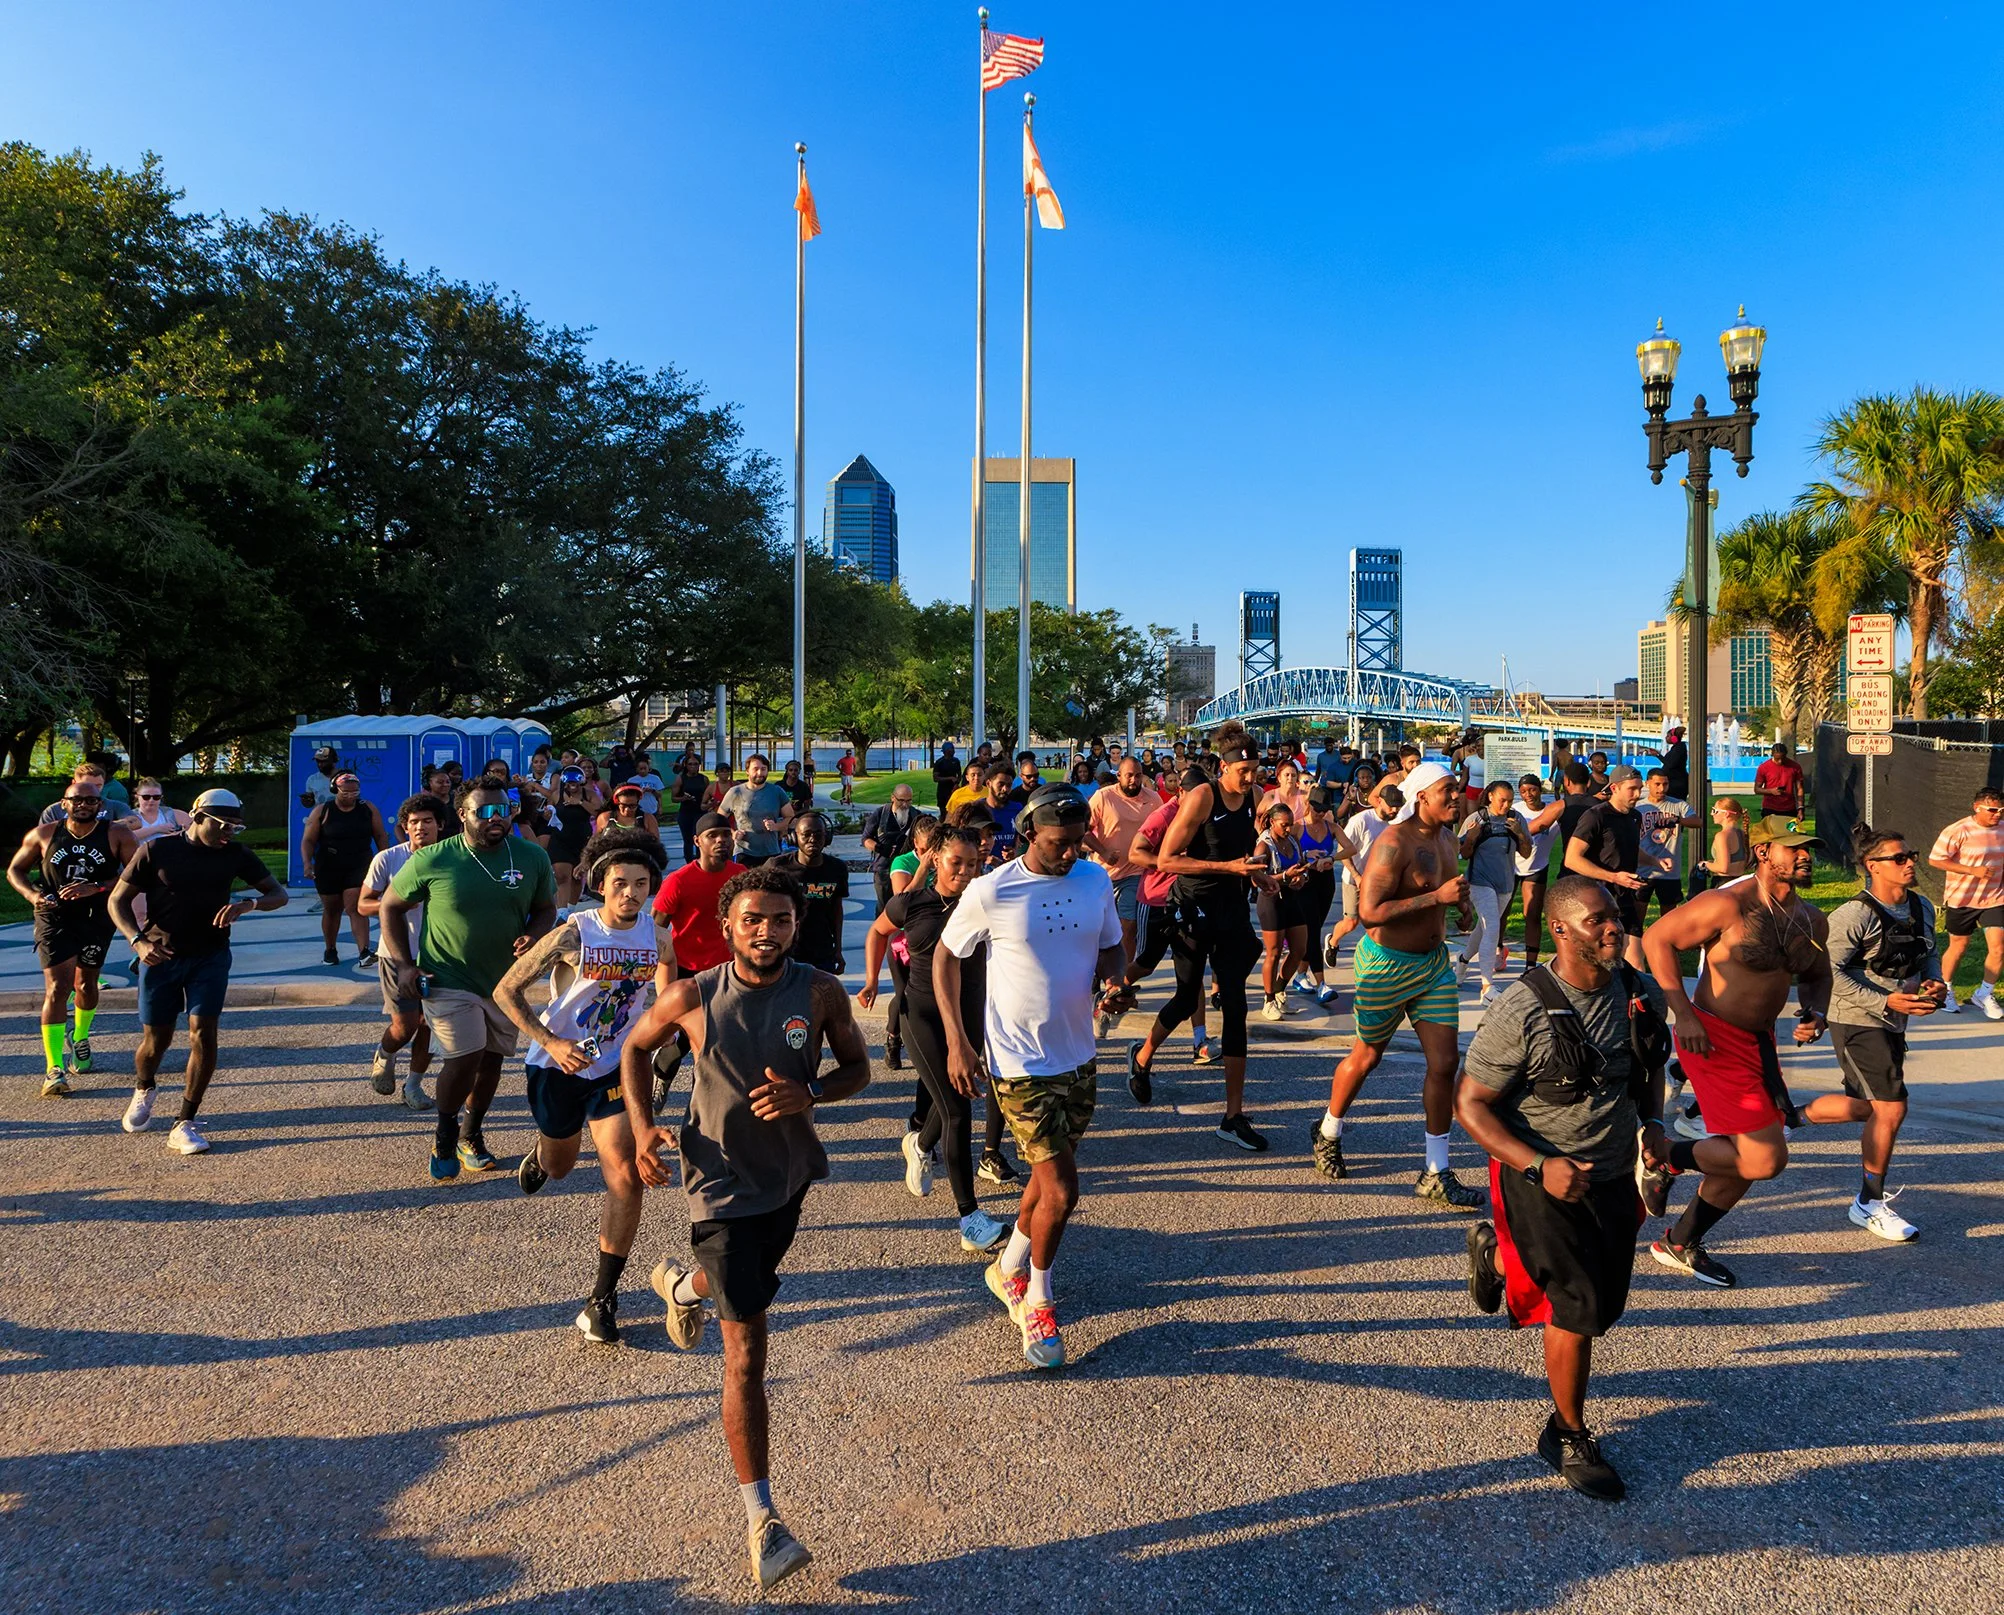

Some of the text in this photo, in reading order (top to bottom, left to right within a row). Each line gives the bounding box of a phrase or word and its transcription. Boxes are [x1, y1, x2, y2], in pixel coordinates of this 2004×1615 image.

[1851, 619, 1890, 630] NO PARKING
[1859, 636, 1882, 644] ANY
[1862, 699, 1878, 707] AND
[1852, 709, 1888, 717] UNLOADING
[1857, 718, 1882, 726] ONLY
[50, 845, 106, 865] RUN OR DIE
[584, 947, 659, 967] HUNTER
